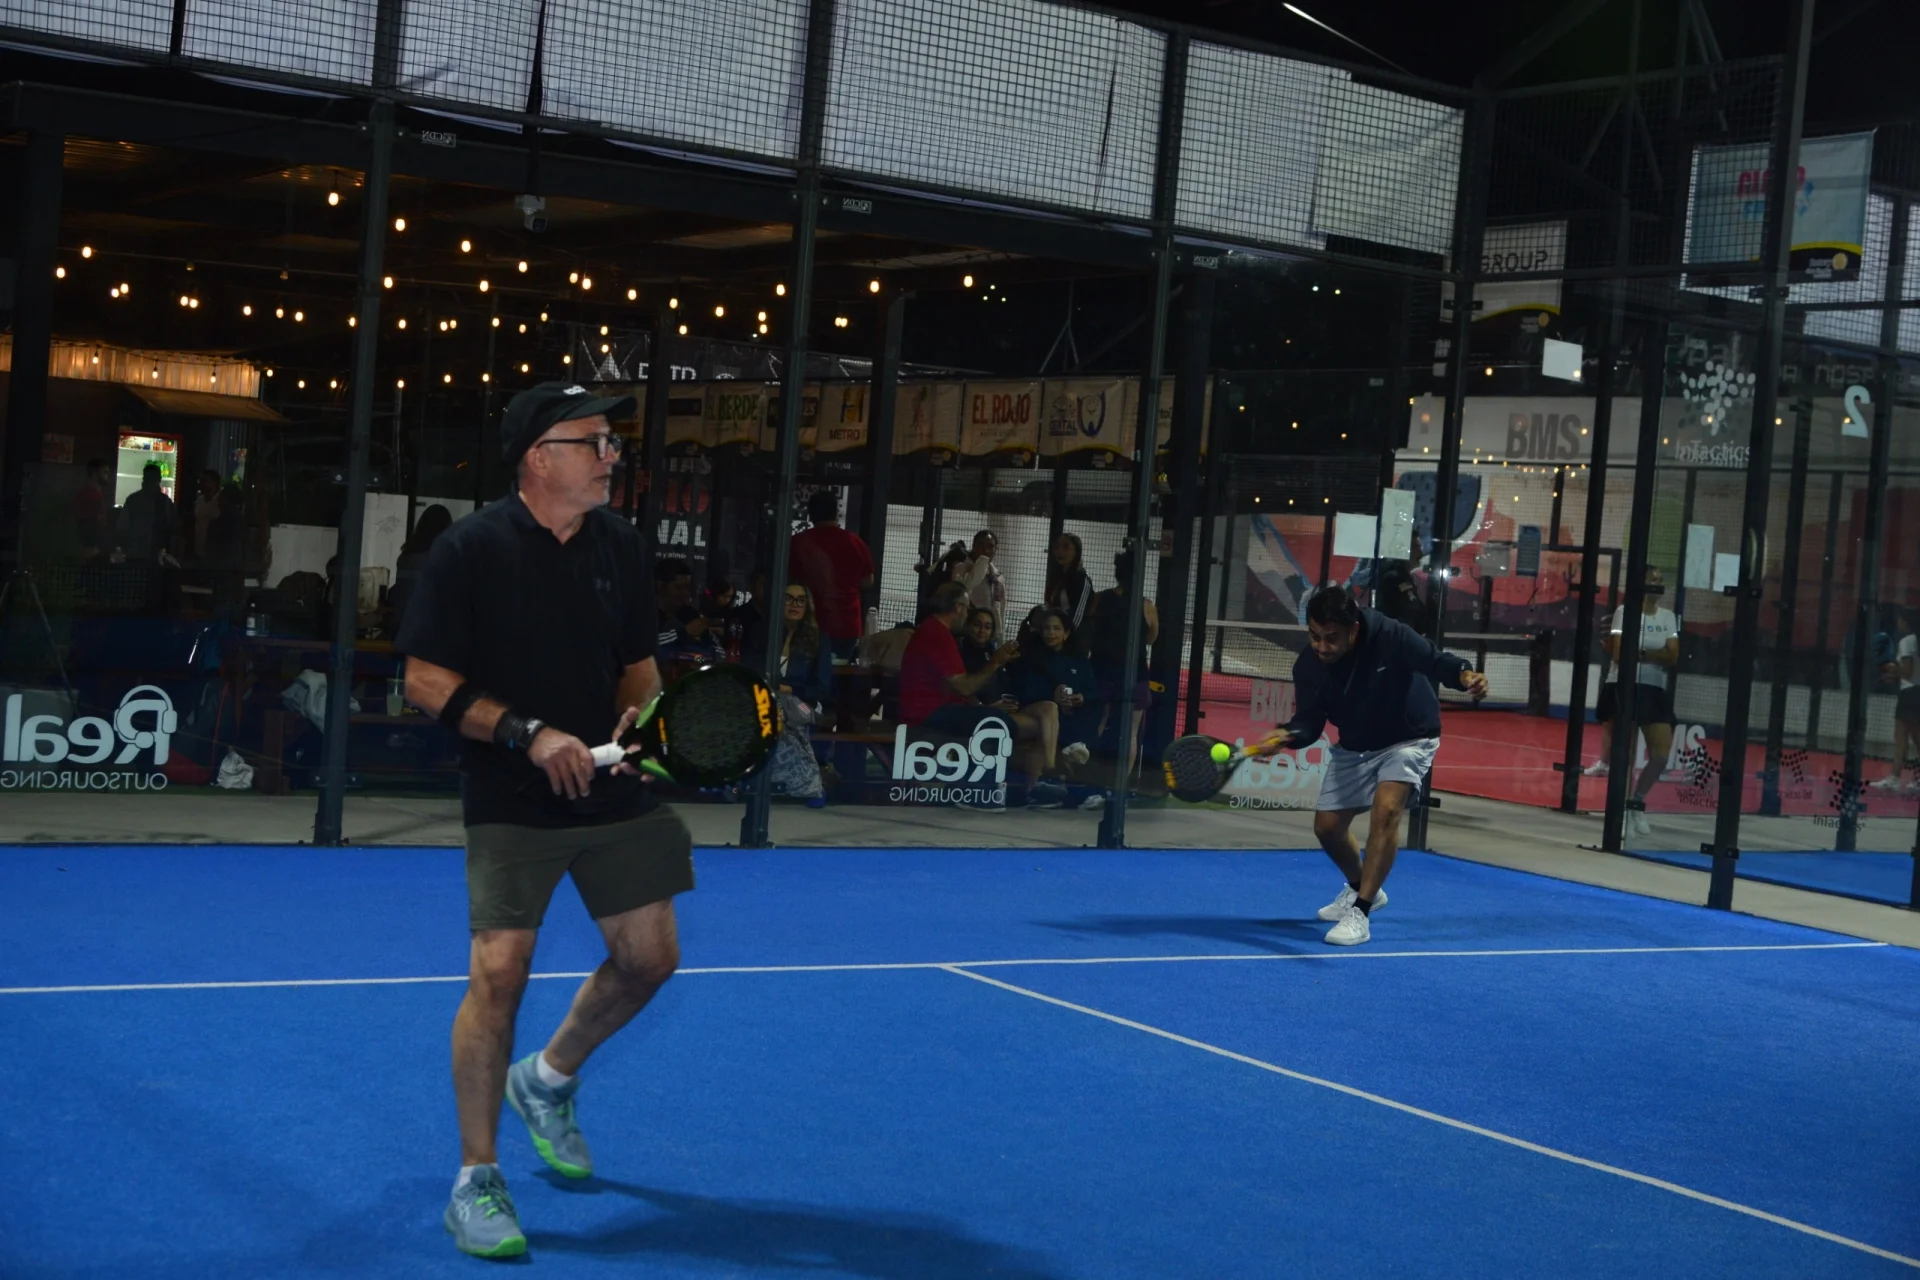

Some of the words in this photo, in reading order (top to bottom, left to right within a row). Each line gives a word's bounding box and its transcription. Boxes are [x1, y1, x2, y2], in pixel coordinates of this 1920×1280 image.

[972, 394, 988, 424] EL
[992, 393, 1031, 425] ROJO
[829, 429, 860, 441] METRO
[1505, 413, 1581, 461] BMS
